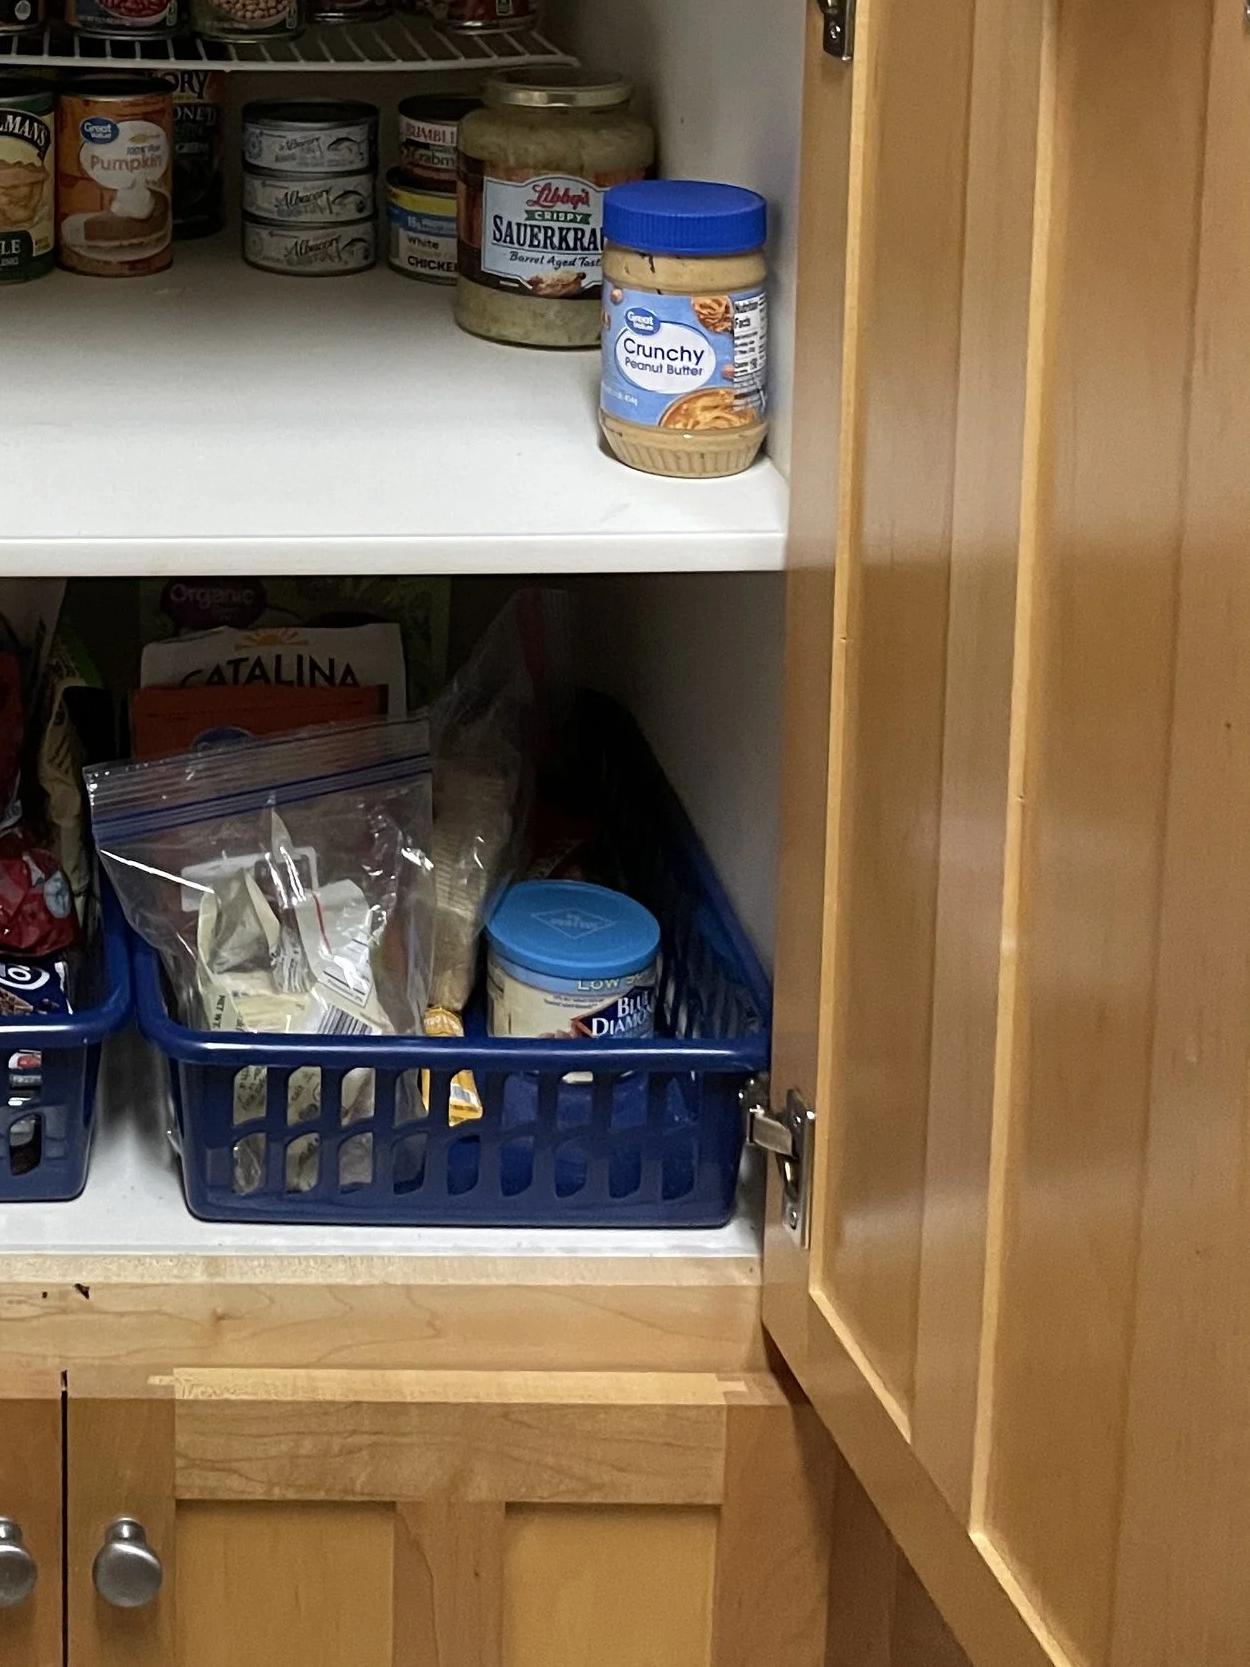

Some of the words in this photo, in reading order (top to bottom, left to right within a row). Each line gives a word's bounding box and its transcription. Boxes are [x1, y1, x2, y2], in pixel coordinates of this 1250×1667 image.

[83, 122, 111, 133] Great
[90, 154, 163, 173] Pumpkin
[526, 182, 591, 210] Libby's
[535, 211, 583, 222] CRISPY
[408, 236, 439, 250] White
[509, 251, 544, 265] Barrel
[547, 255, 576, 270] Aged
[627, 311, 653, 324] Great
[623, 338, 704, 365] Crunchy
[625, 358, 662, 373] Peanut
[667, 366, 703, 376] Butter
[168, 583, 255, 609] Organic
